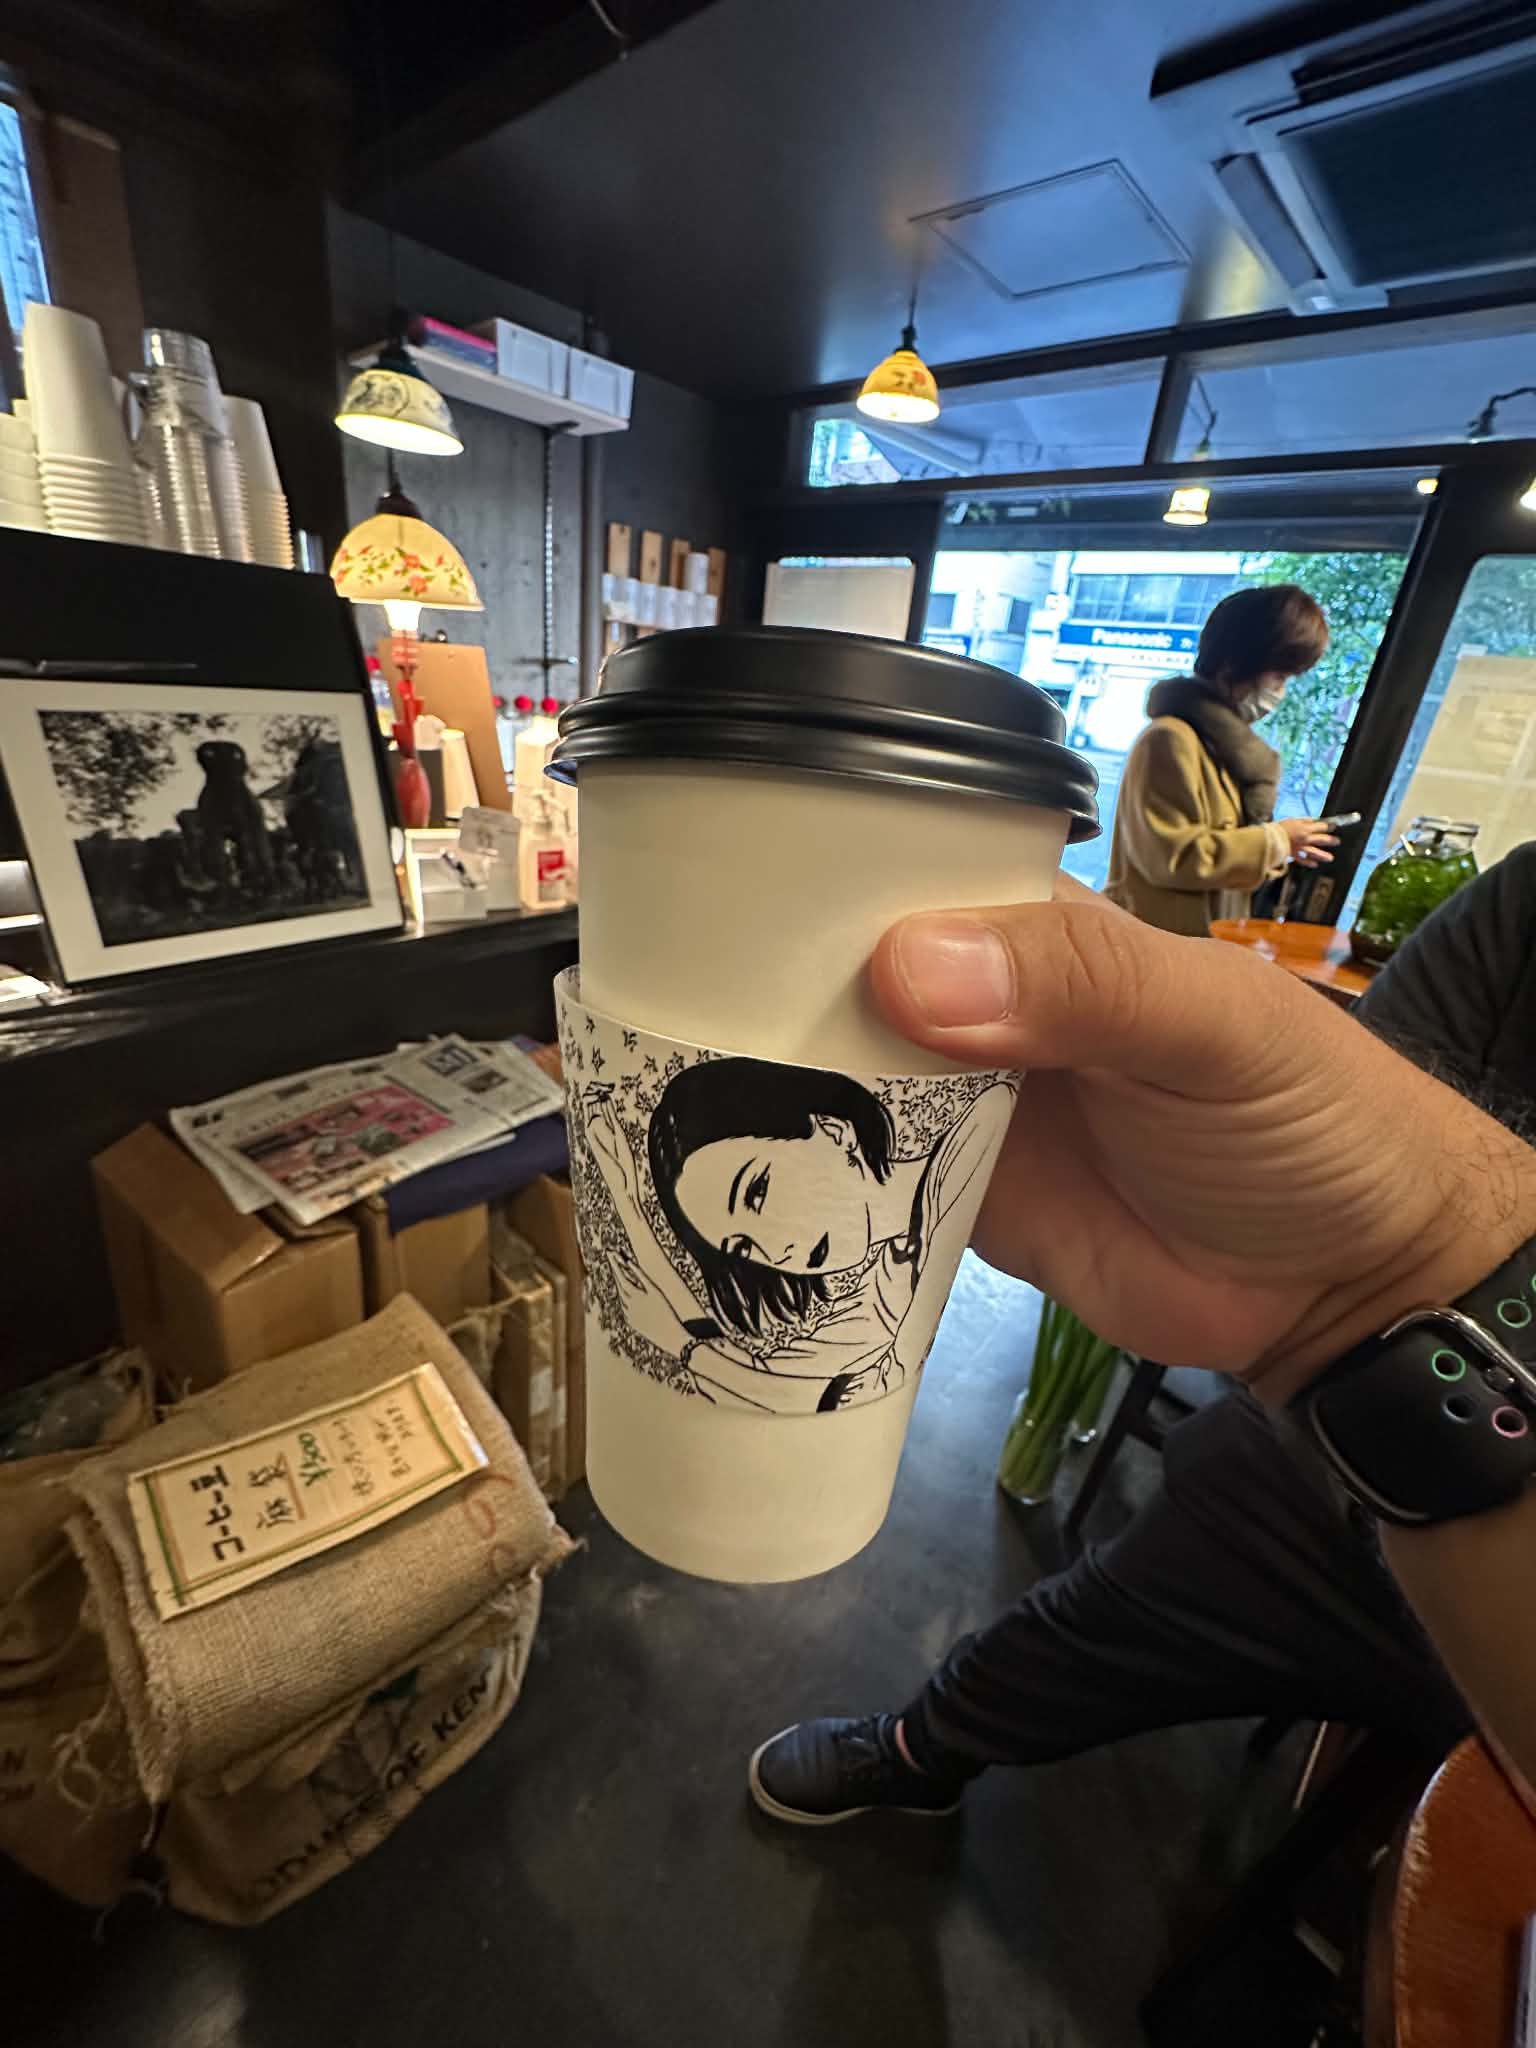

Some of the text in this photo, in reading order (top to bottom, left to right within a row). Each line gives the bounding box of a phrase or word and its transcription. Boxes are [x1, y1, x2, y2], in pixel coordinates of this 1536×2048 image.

[190, 1465, 245, 1561] コーヒー豆
